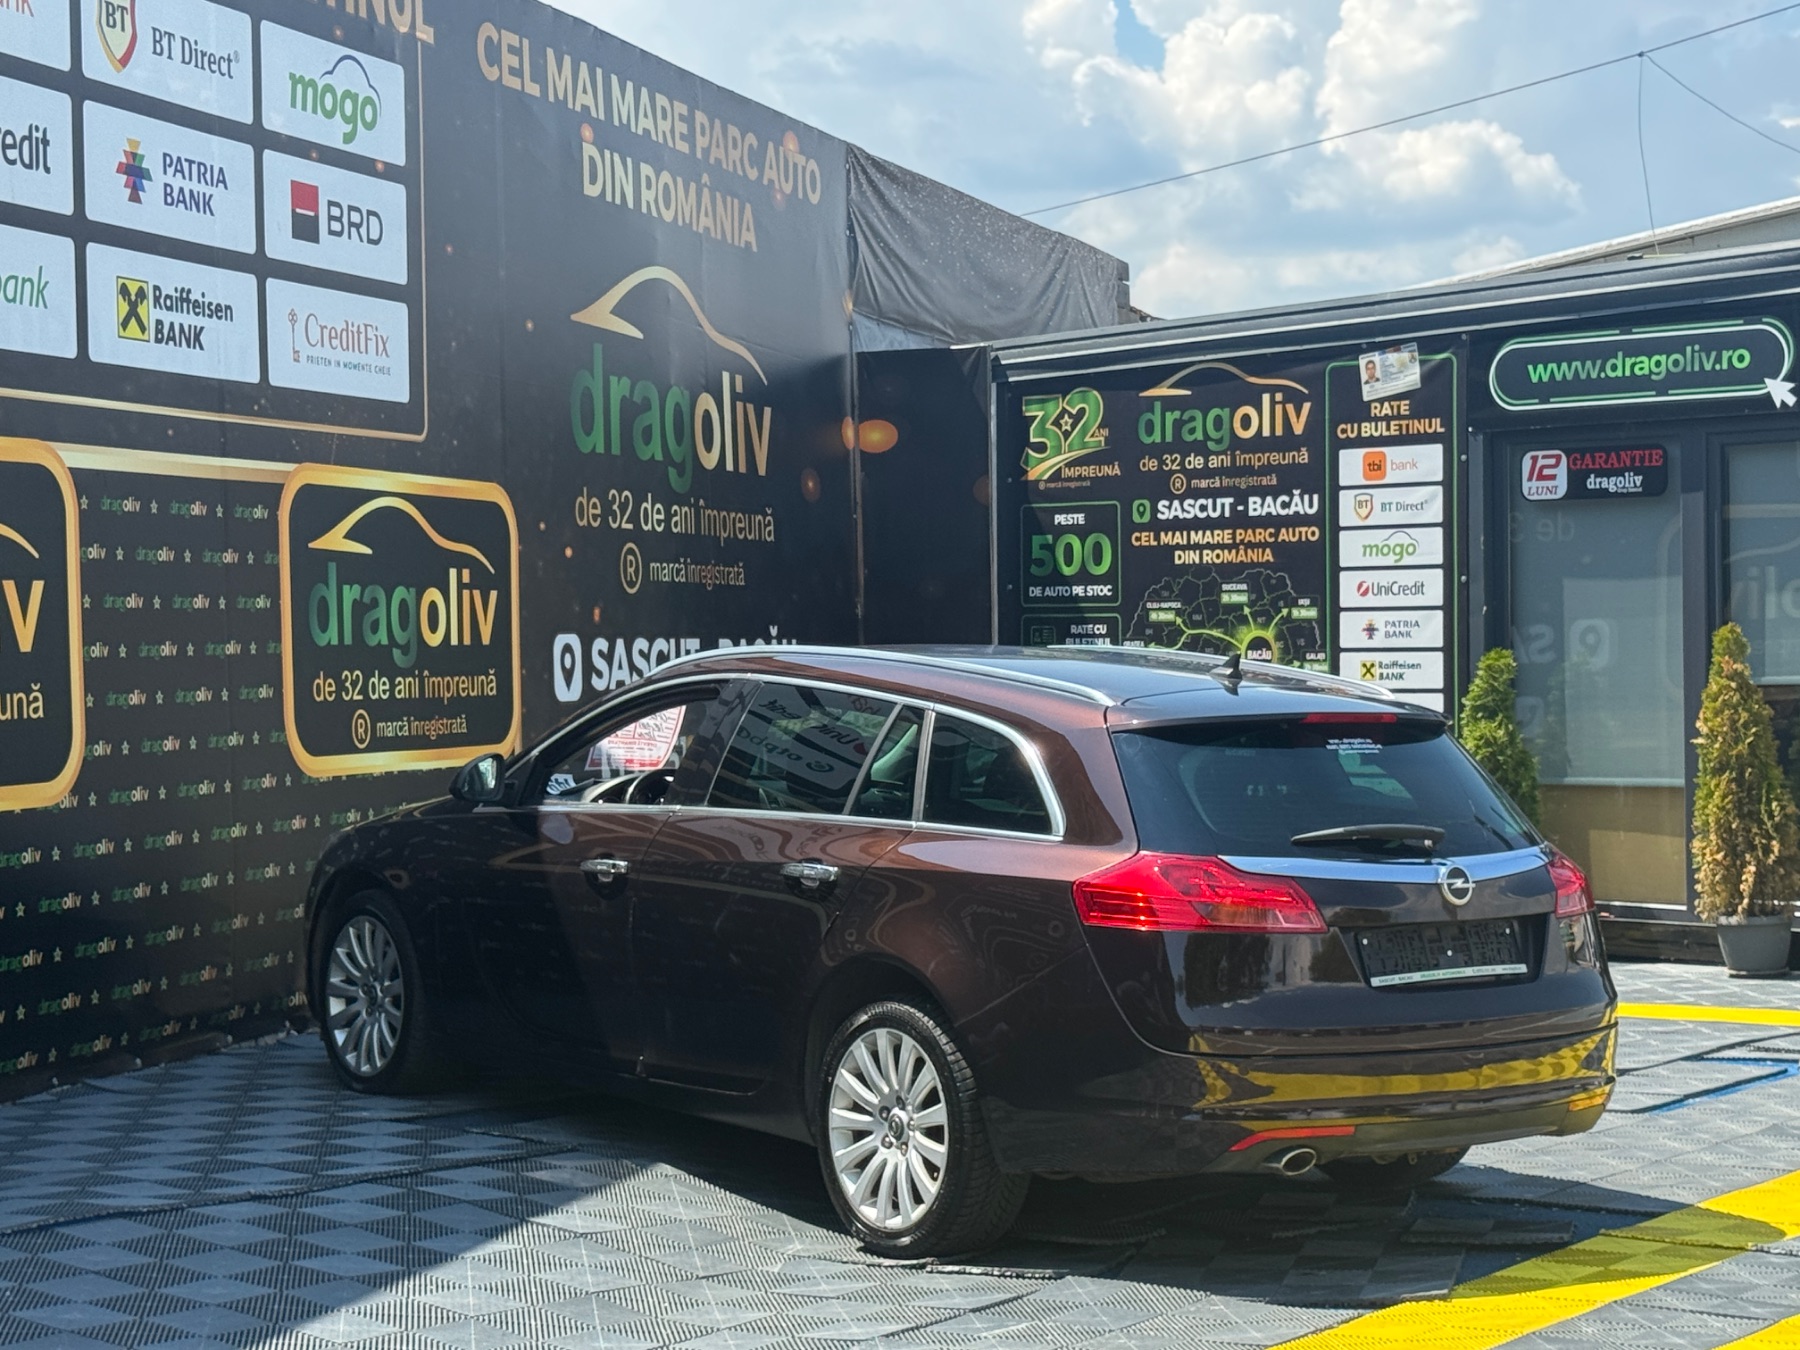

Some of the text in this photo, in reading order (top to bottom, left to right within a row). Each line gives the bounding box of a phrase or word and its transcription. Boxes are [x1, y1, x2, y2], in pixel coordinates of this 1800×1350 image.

[105, 1, 129, 32] BT
[151, 26, 175, 61] BT
[289, 72, 377, 144] mogo
[477, 22, 540, 98] CEL
[546, 47, 605, 121] MAI
[610, 73, 690, 155] MARE
[695, 109, 759, 181] PARC
[762, 141, 821, 205] AUTO
[0, 123, 51, 174] edit
[162, 152, 228, 191] PATRIA
[163, 183, 215, 217] BANK
[582, 140, 758, 252] DIN ROMÂNIA
[327, 200, 383, 246] BRD
[152, 284, 234, 324] Raiffeisen
[154, 319, 205, 352] BANK
[304, 313, 391, 358] CreditFix
[306, 354, 332, 367] PRIETEN
[1527, 344, 1751, 384] www.dragoliv.ro
[570, 343, 771, 494] dragoliv
[1137, 392, 1312, 451] dragoliv
[1370, 400, 1410, 417] RATE
[1337, 418, 1445, 439] CU BULETINUL
[1140, 448, 1309, 471] de 32 de ani împreună
[1367, 458, 1418, 472] tbi bank
[1527, 449, 1663, 483] 12 GARANTIE
[1191, 475, 1221, 489] marcă
[1527, 485, 1558, 497] LUNI
[1586, 472, 1643, 492] dragoliv
[101, 495, 268, 522] dragoliv dragoliv dragoliv
[575, 487, 775, 547] de 32 de ani împreună
[1157, 498, 1234, 520] SASCUT
[1248, 489, 1319, 517] BACĂU
[1380, 502, 1393, 512] BT
[1054, 513, 1085, 526] PESTE
[1131, 526, 1320, 547] CEL MAI MARE PARC AUTO
[81, 543, 239, 567] goliv dragoliv dragoliv
[1030, 533, 1112, 577] 500
[1174, 546, 1274, 565] DIN ROMÂNIA
[1362, 542, 1417, 563] mogo
[650, 558, 686, 583] marcă
[687, 558, 745, 590] înregistrată
[1029, 584, 1113, 597] DE AUTO PE STOC
[1371, 581, 1425, 596] UniCredit
[104, 593, 271, 612] dragoliv dragoliv dragoliv
[308, 561, 498, 669] dragoliv
[1070, 623, 1107, 635] RATE CU
[1384, 620, 1420, 629] PATRIA
[1384, 630, 1412, 639] BANK
[84, 640, 241, 661] goliv dragoliv dragoliv
[1378, 660, 1421, 671] Raiffeisen
[1378, 671, 1405, 681] BANK
[106, 684, 273, 709] dragoliv dragoliv dragoliv
[313, 668, 497, 705] de 32 de ani împreună
[377, 715, 409, 737] marcă
[410, 714, 467, 740] înregistrată
[141, 735, 180, 755] dragoliv
[208, 731, 244, 749] dragoliv
[109, 786, 149, 806] dragoliv
[177, 780, 216, 799] dragoliv
[242, 773, 277, 792] dragoliv
[73, 839, 115, 859] dragoliv
[144, 830, 183, 850] dragoliv
[210, 822, 247, 842] dragoliv
[39, 892, 82, 914] dragoliv
[111, 882, 151, 903] dragoliv
